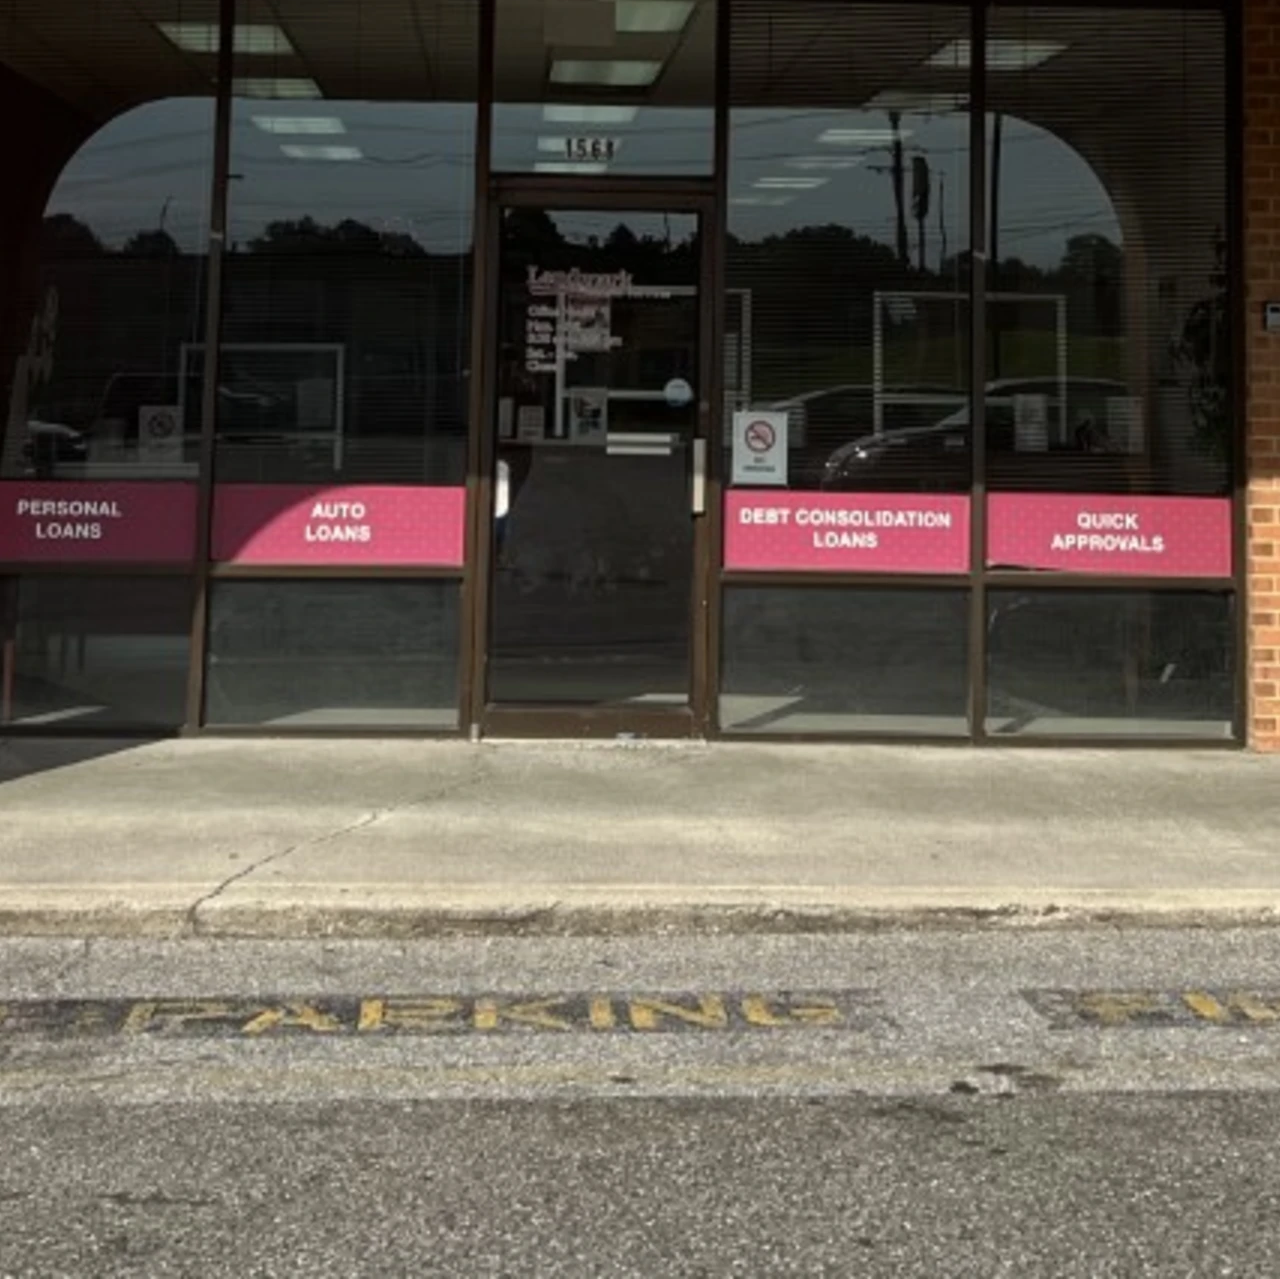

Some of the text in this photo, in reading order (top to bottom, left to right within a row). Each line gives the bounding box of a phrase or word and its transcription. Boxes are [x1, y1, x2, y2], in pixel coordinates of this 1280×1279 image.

[17, 499, 122, 517] PERSONAL
[311, 503, 365, 519] AUTO
[739, 507, 952, 528] DEBT CONSOLIDATION
[1077, 513, 1138, 530] QUICK
[35, 523, 102, 539] LOANS
[305, 525, 371, 542] LOANS
[813, 531, 878, 549] LOANS
[1051, 534, 1164, 552] APPROVALS
[118, 991, 842, 1035] PARKING
